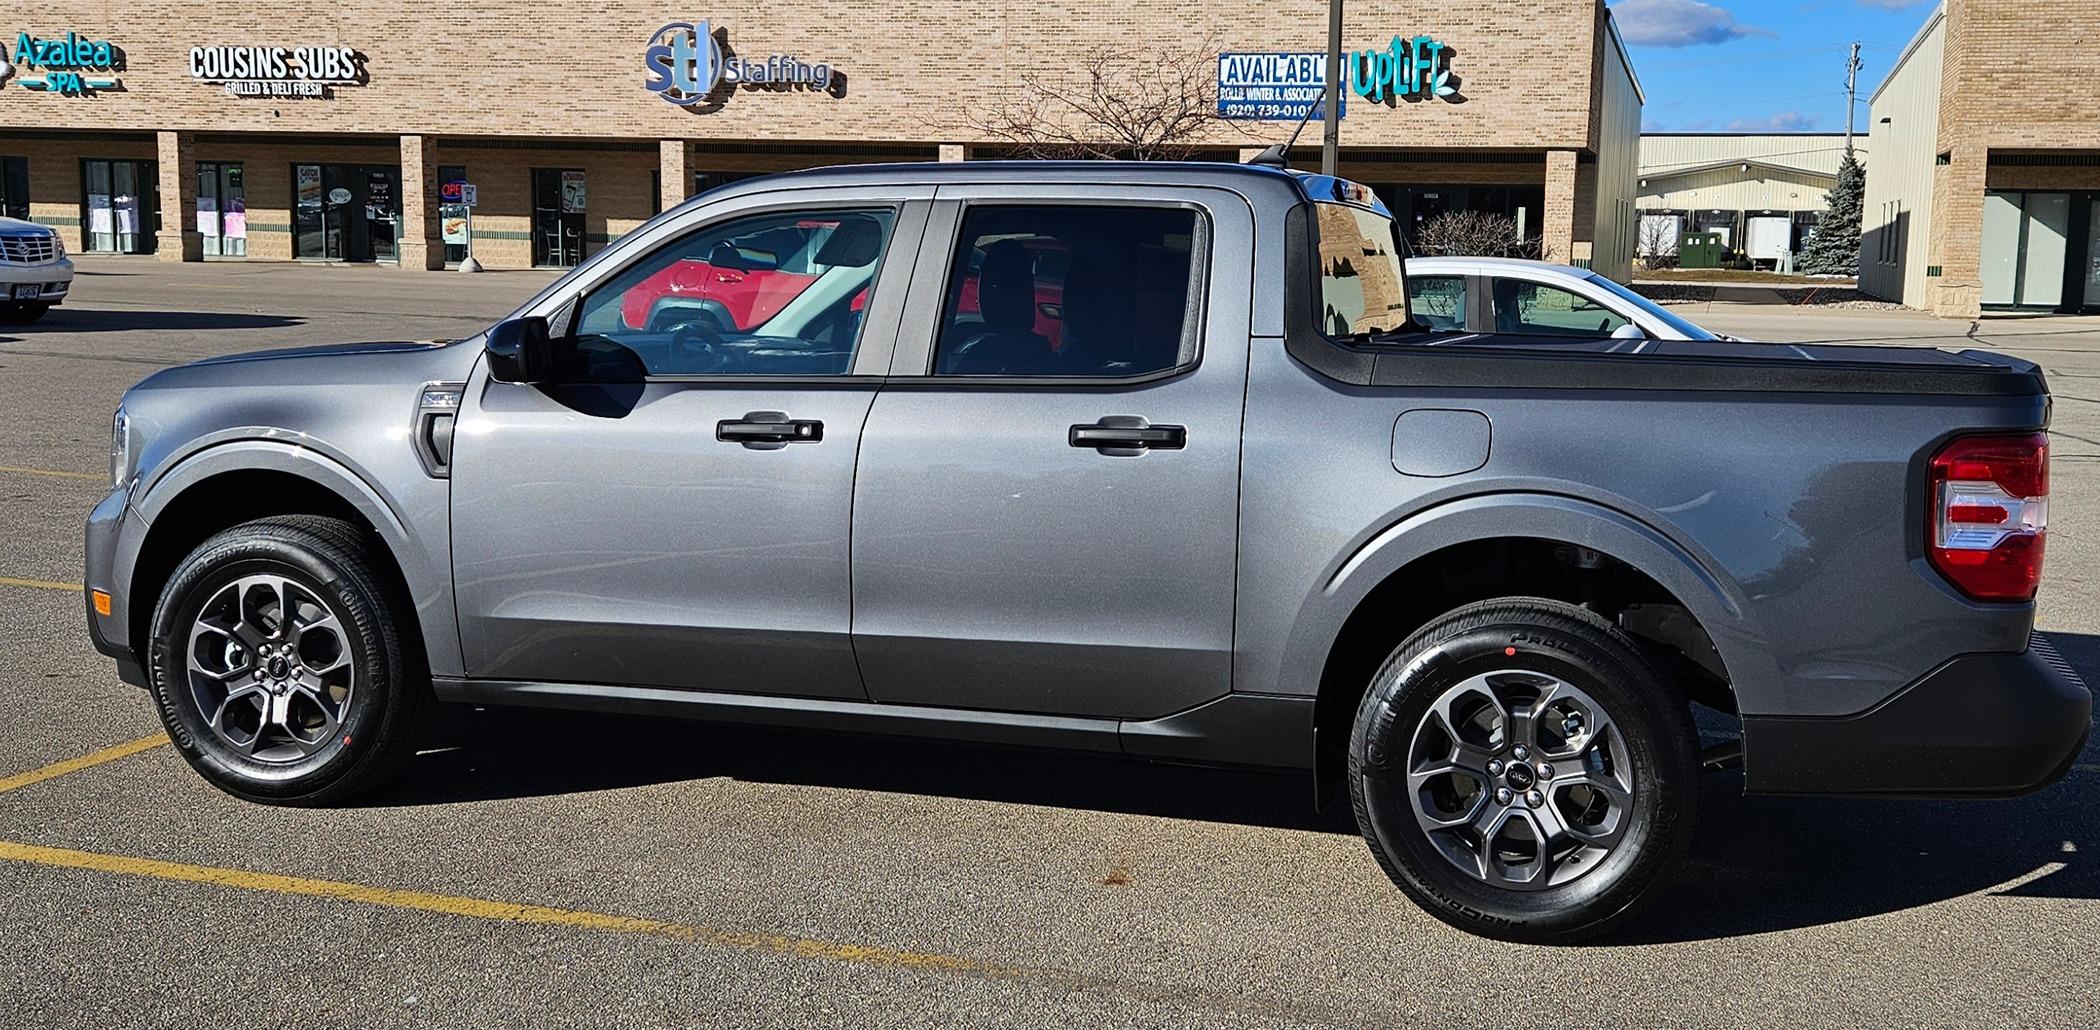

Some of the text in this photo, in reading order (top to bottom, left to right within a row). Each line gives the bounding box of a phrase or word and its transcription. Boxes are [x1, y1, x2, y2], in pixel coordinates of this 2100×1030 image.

[13, 31, 112, 66] Azalea
[189, 47, 355, 79] COUSINS SUBS
[724, 55, 830, 88] Staffing
[1226, 57, 1327, 82] AVAILABL
[46, 72, 81, 92] SPA
[224, 82, 323, 96] GRILLED & DELI FRESH
[1246, 87, 1275, 100] WINTER
[1226, 104, 1256, 117] (920)
[442, 183, 462, 196] OPE
